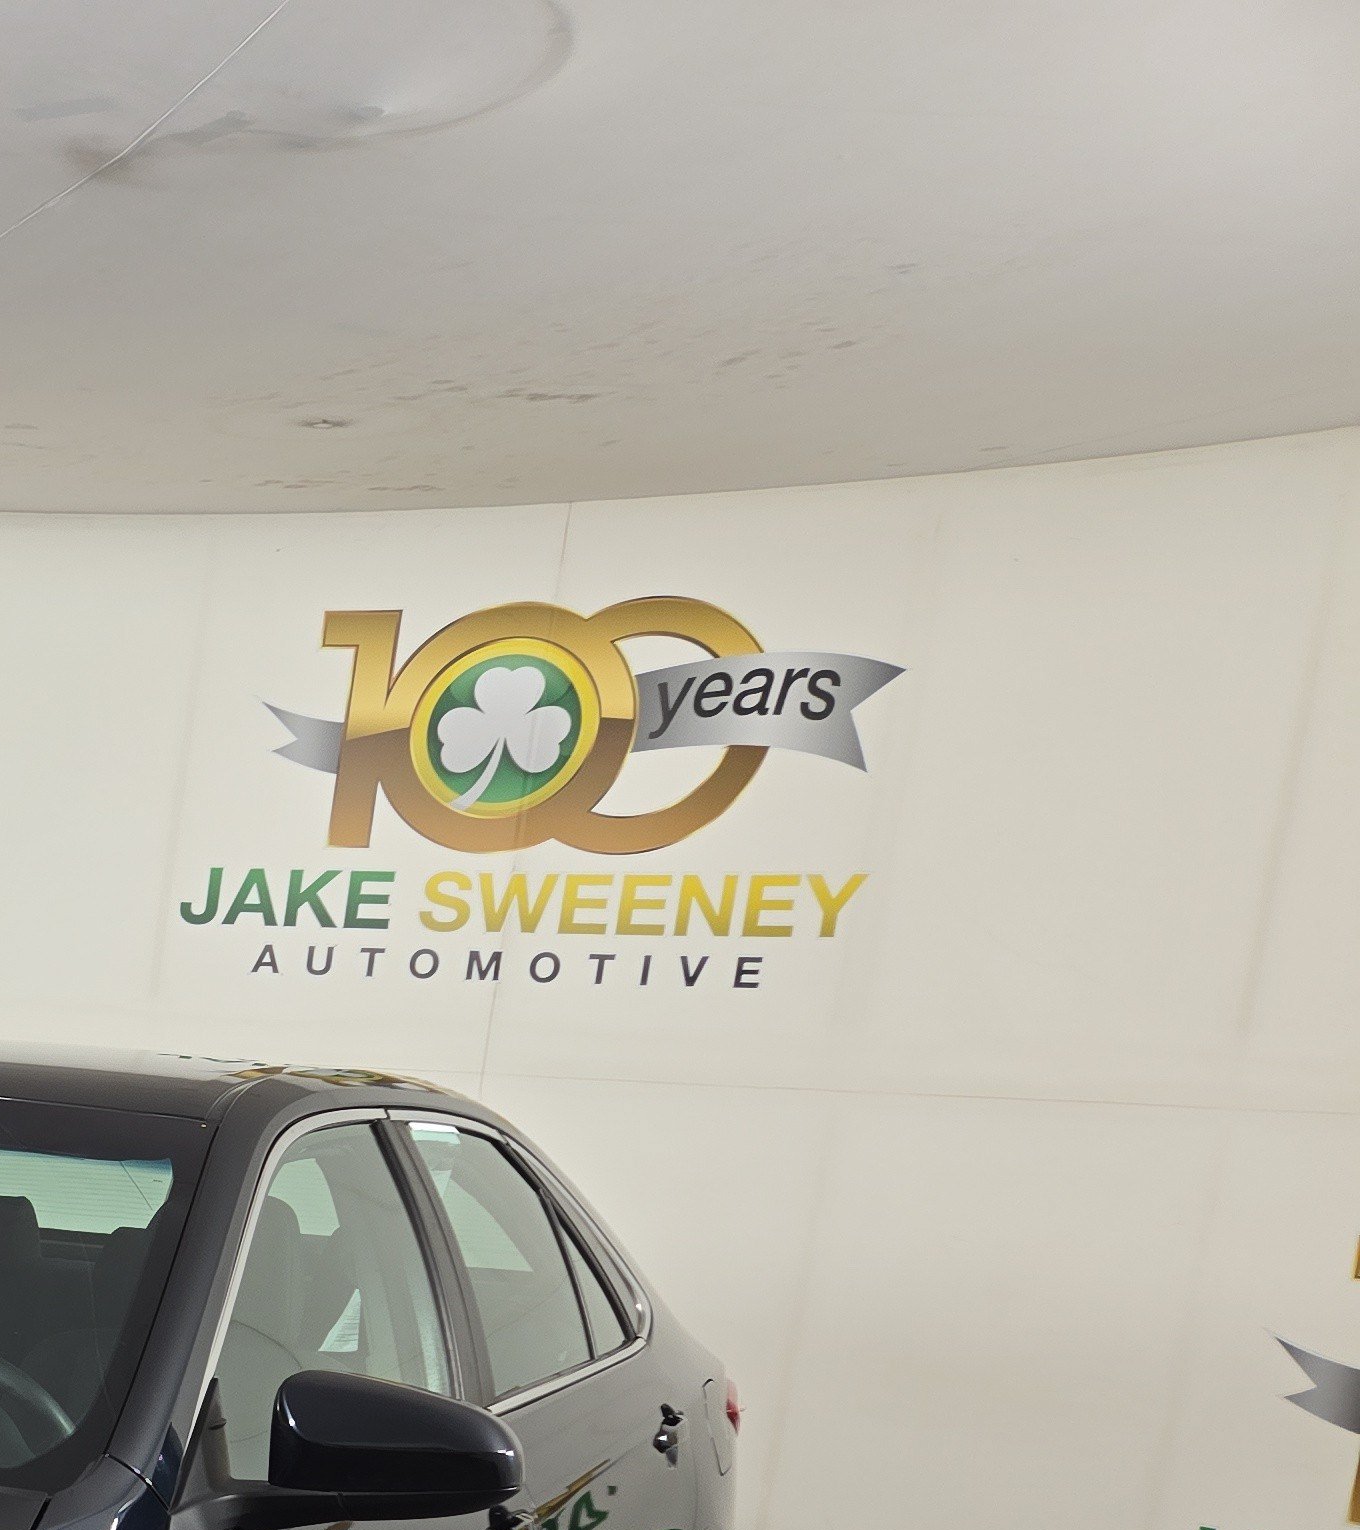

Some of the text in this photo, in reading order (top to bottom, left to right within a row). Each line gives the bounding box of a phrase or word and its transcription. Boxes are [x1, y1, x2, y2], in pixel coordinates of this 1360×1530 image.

[321, 595, 842, 855] 100 years
[180, 867, 869, 938] JAKE SWEENEY
[251, 945, 764, 989] AUTOMOTIVE
